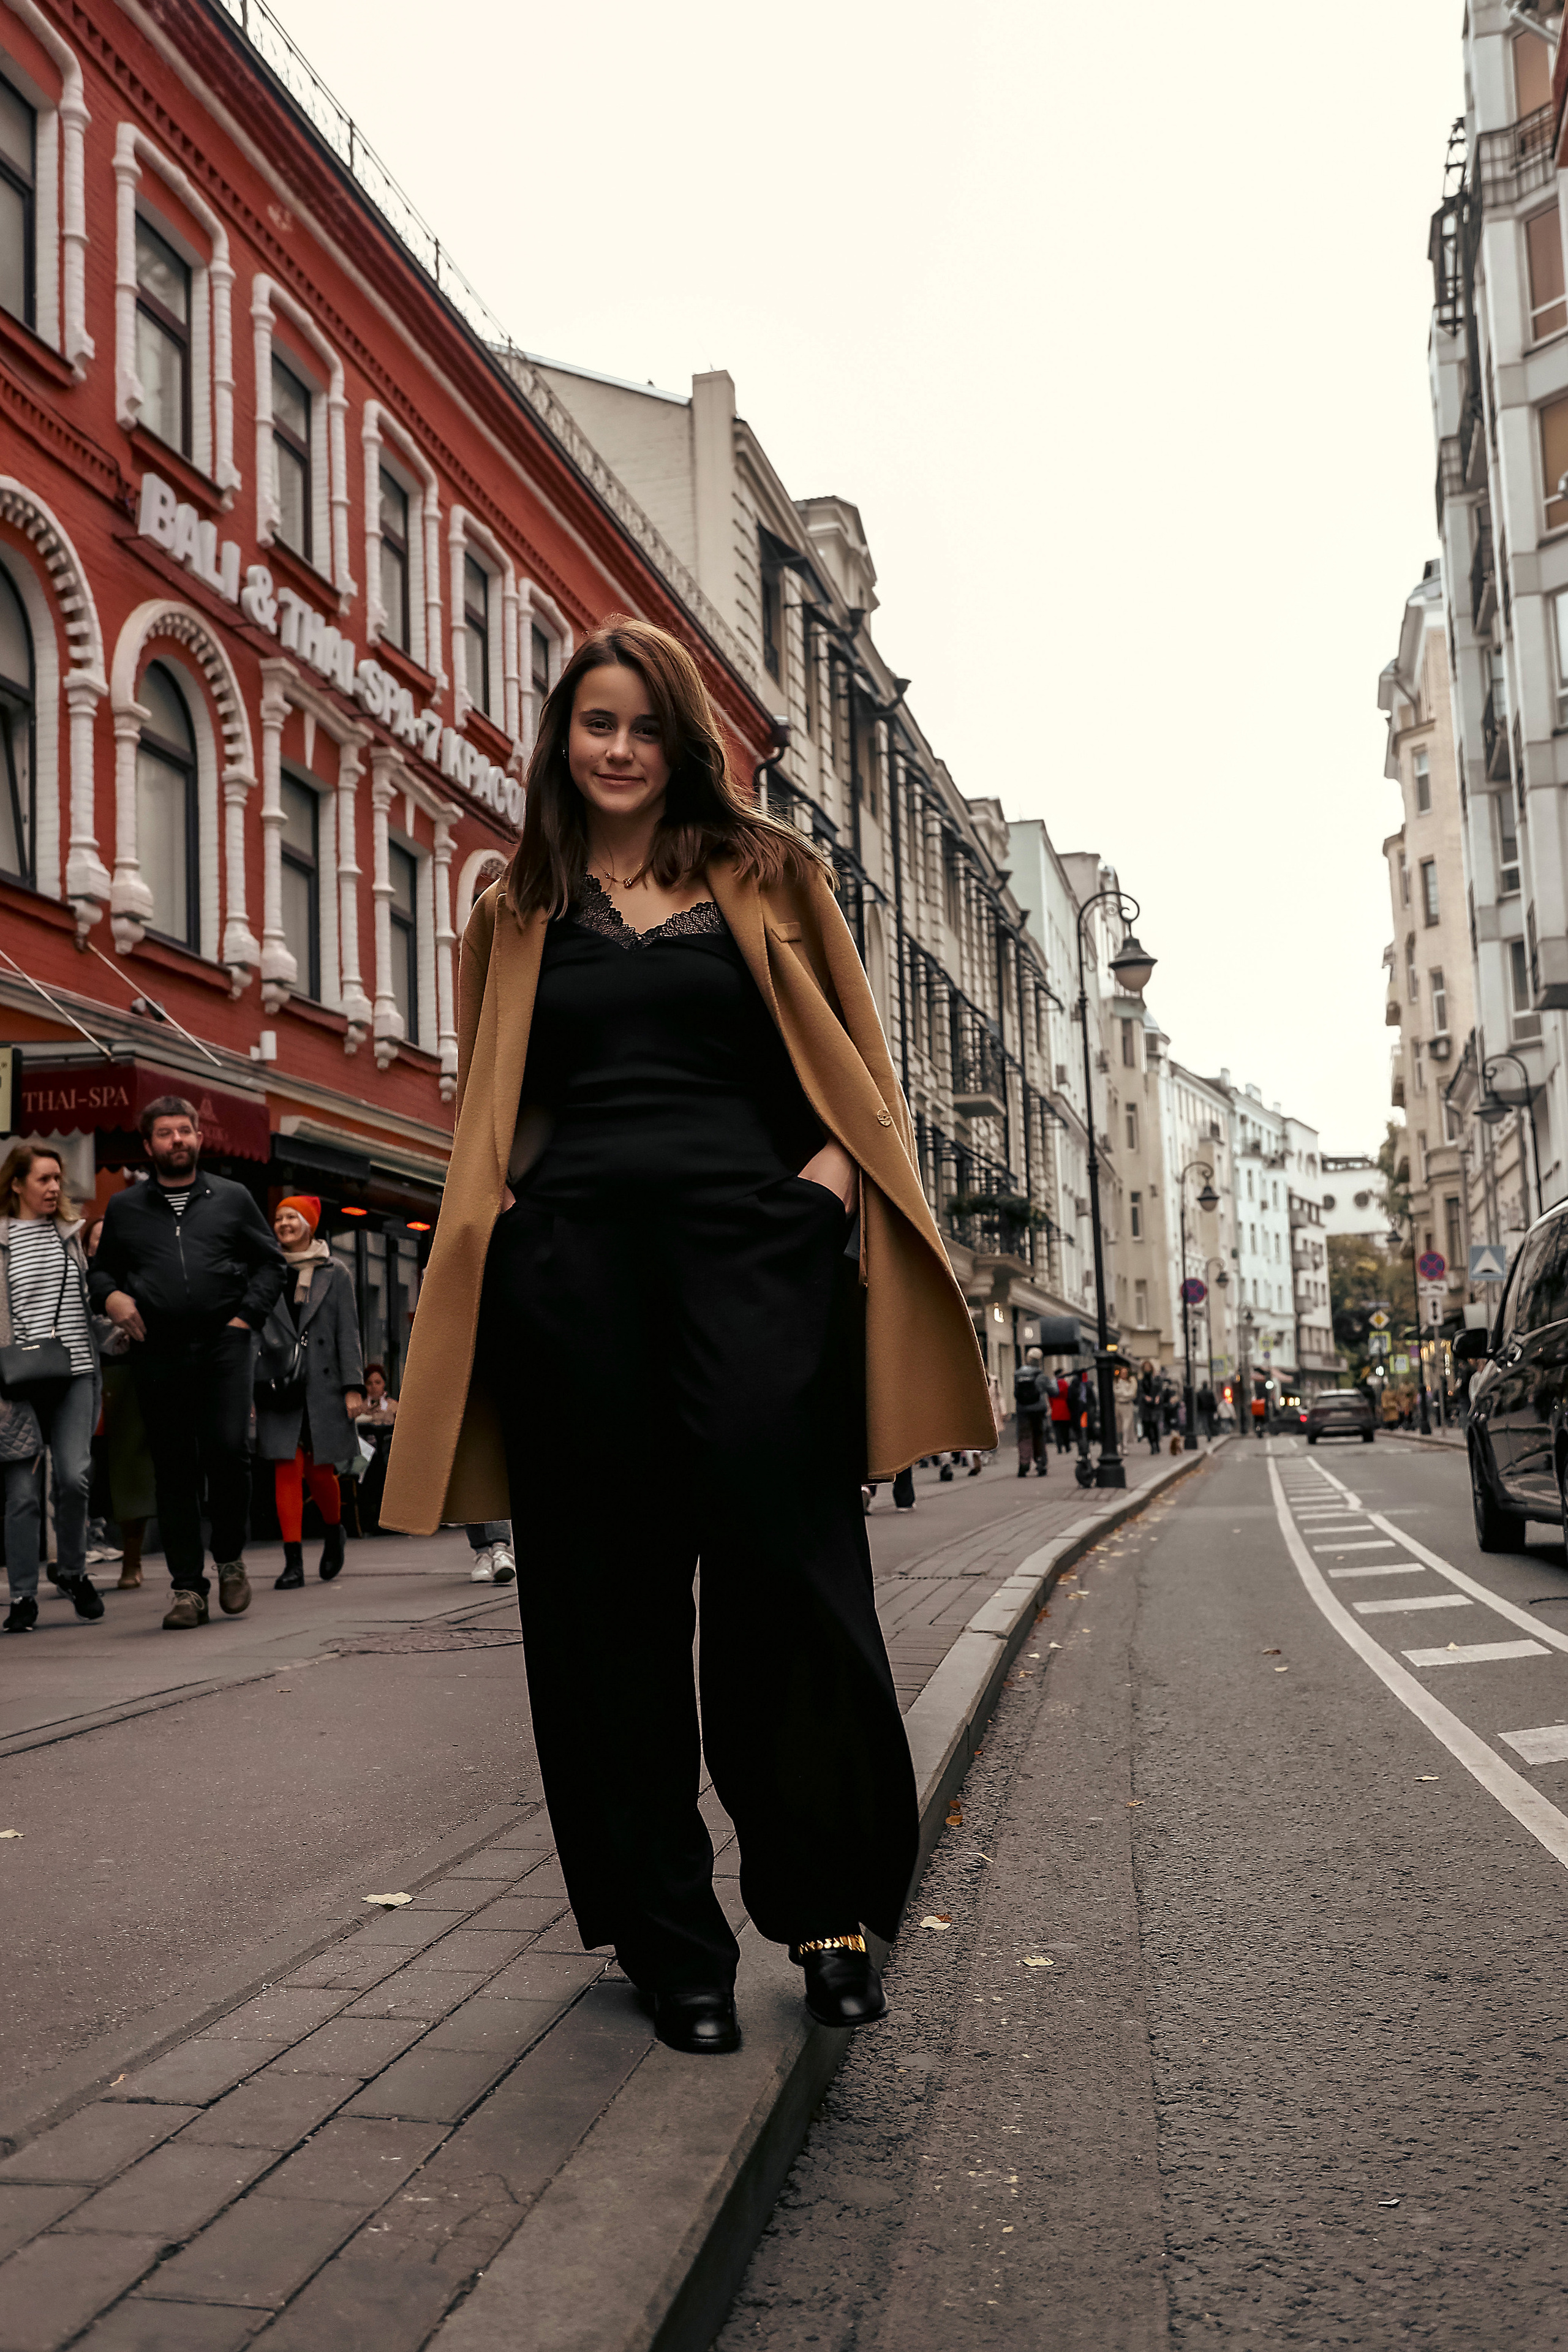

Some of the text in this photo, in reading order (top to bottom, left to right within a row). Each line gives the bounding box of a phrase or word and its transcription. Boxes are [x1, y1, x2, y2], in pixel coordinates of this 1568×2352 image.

[138, 472, 241, 605] BALI
[241, 564, 278, 635] &
[441, 727, 526, 829] КРАСО
[22, 1085, 129, 1112] THAI-SPA
